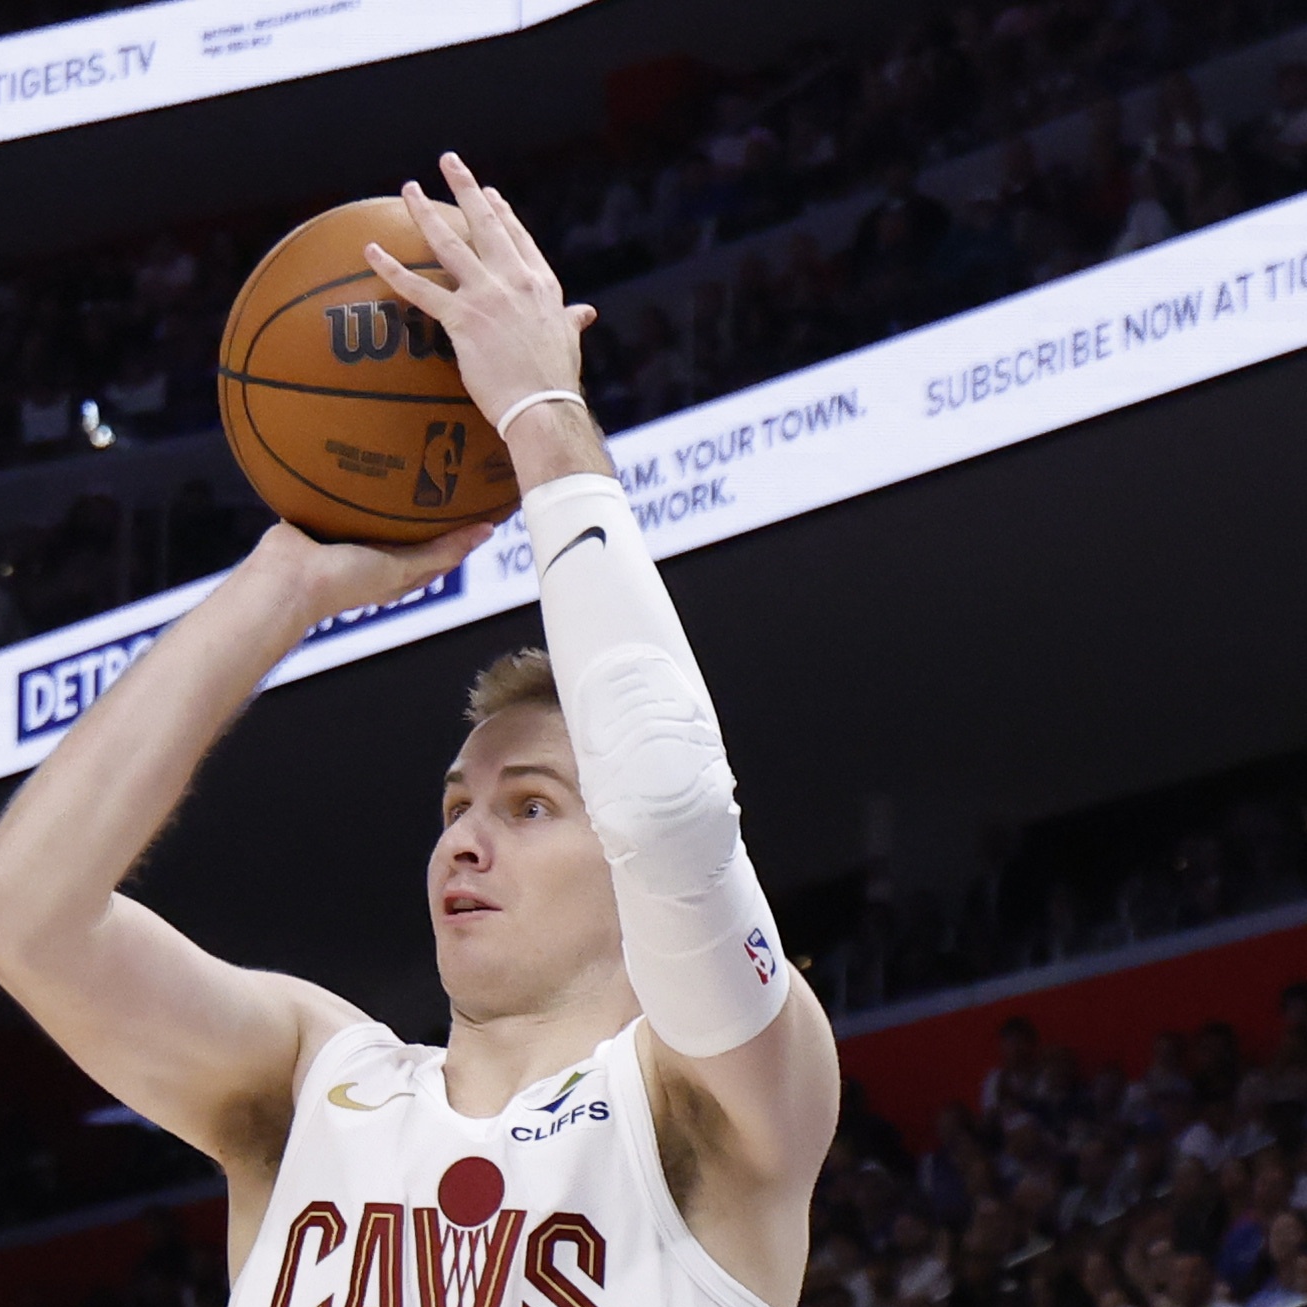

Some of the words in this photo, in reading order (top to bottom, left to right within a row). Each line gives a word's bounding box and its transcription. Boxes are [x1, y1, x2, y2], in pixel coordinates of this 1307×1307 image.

[923, 317, 1114, 419] SUBSCRIBE
[1122, 289, 1204, 351] NOW
[1212, 271, 1255, 321] AT
[674, 423, 755, 476] YOUR
[761, 387, 868, 446] TOWN.
[510, 1101, 610, 1142] CLIFFS
